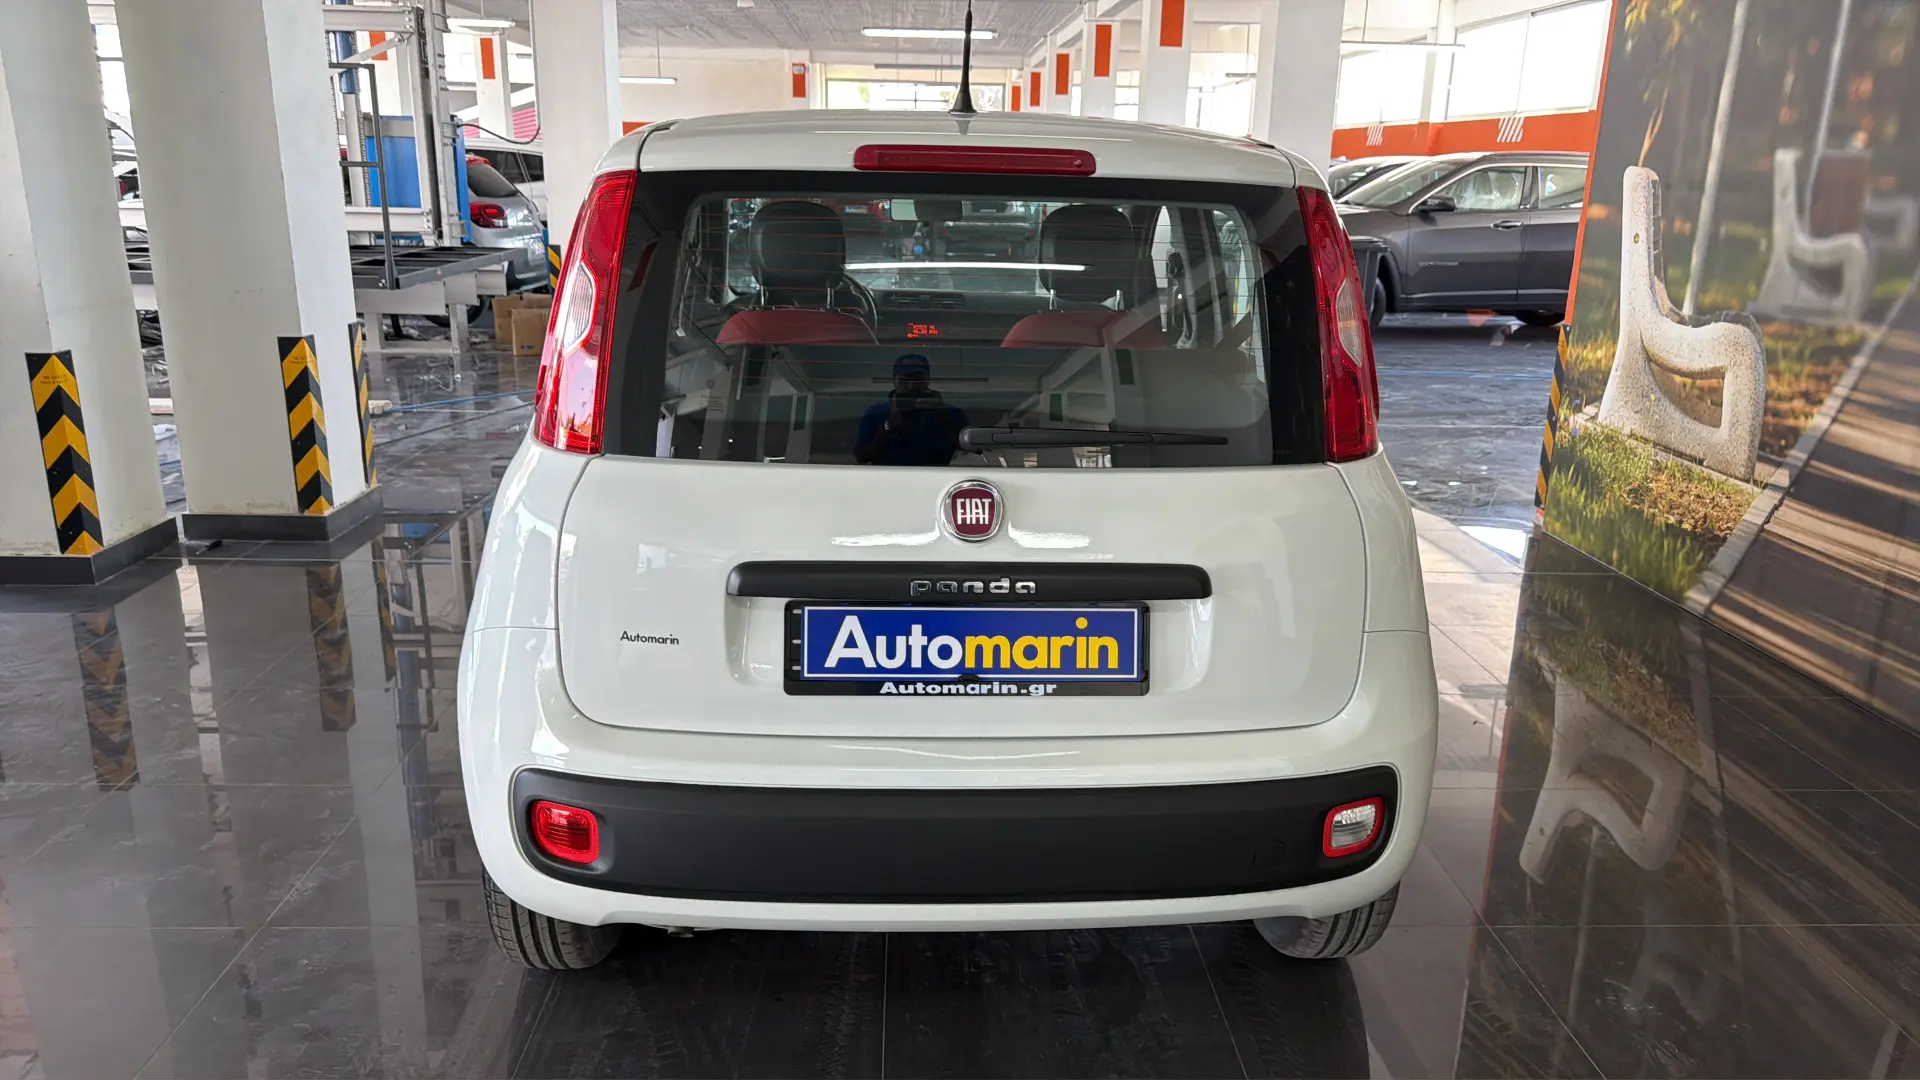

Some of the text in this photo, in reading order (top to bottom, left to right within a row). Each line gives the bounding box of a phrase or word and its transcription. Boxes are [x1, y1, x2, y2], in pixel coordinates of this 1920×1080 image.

[956, 498, 992, 525] FIAT
[910, 577, 1036, 596] panda
[620, 630, 680, 645] Automarin
[824, 614, 1119, 669] Automarin
[879, 681, 1057, 696] Automarin.gr
